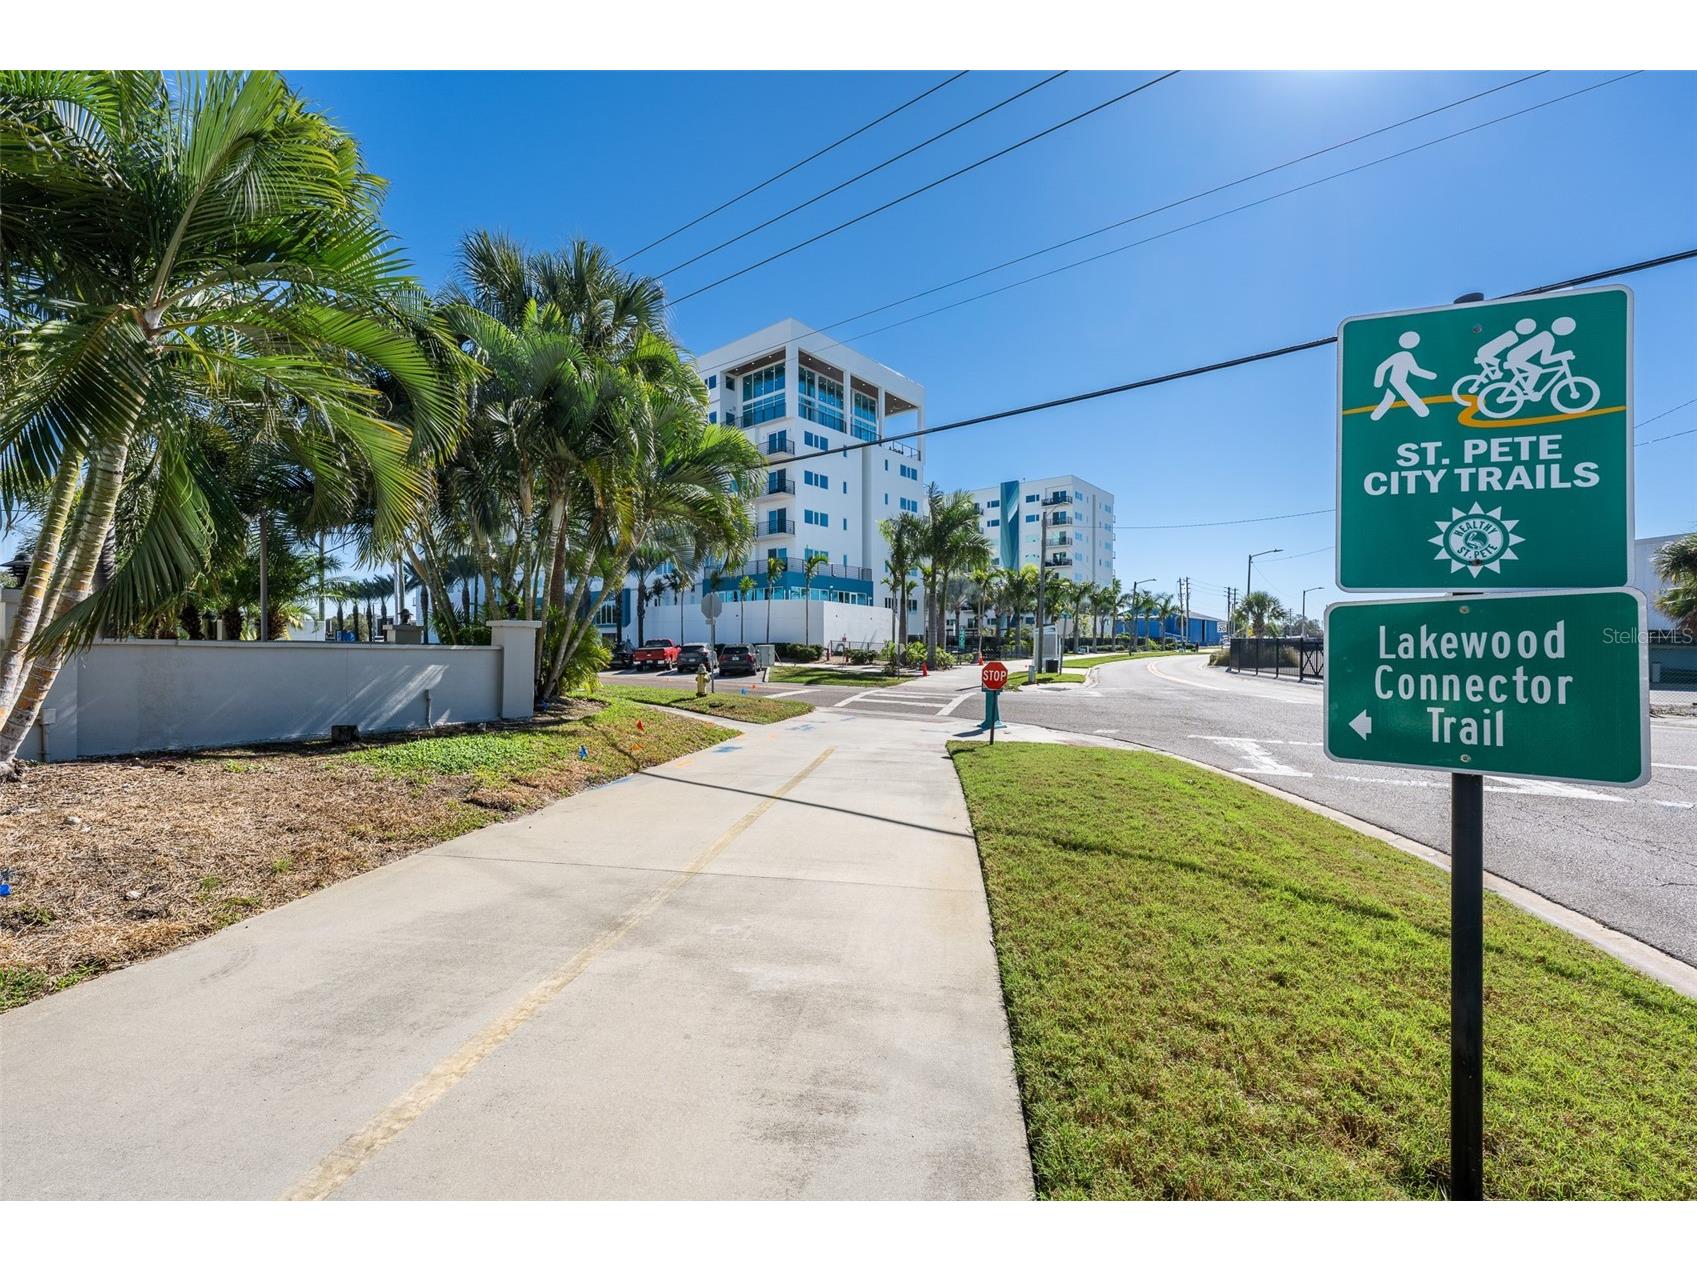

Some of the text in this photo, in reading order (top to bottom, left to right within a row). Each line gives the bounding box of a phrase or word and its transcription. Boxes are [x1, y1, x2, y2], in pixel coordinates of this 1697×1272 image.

[1396, 434, 1562, 467] ST. PETE
[1363, 461, 1600, 496] CITY TRAILS
[1453, 520, 1498, 537] HEALTHY
[1457, 543, 1498, 559] ST. PETE
[1379, 619, 1565, 660] Lakewood
[983, 670, 1006, 681] STOP
[1374, 664, 1574, 705] Connector
[1426, 706, 1504, 747] Trail
